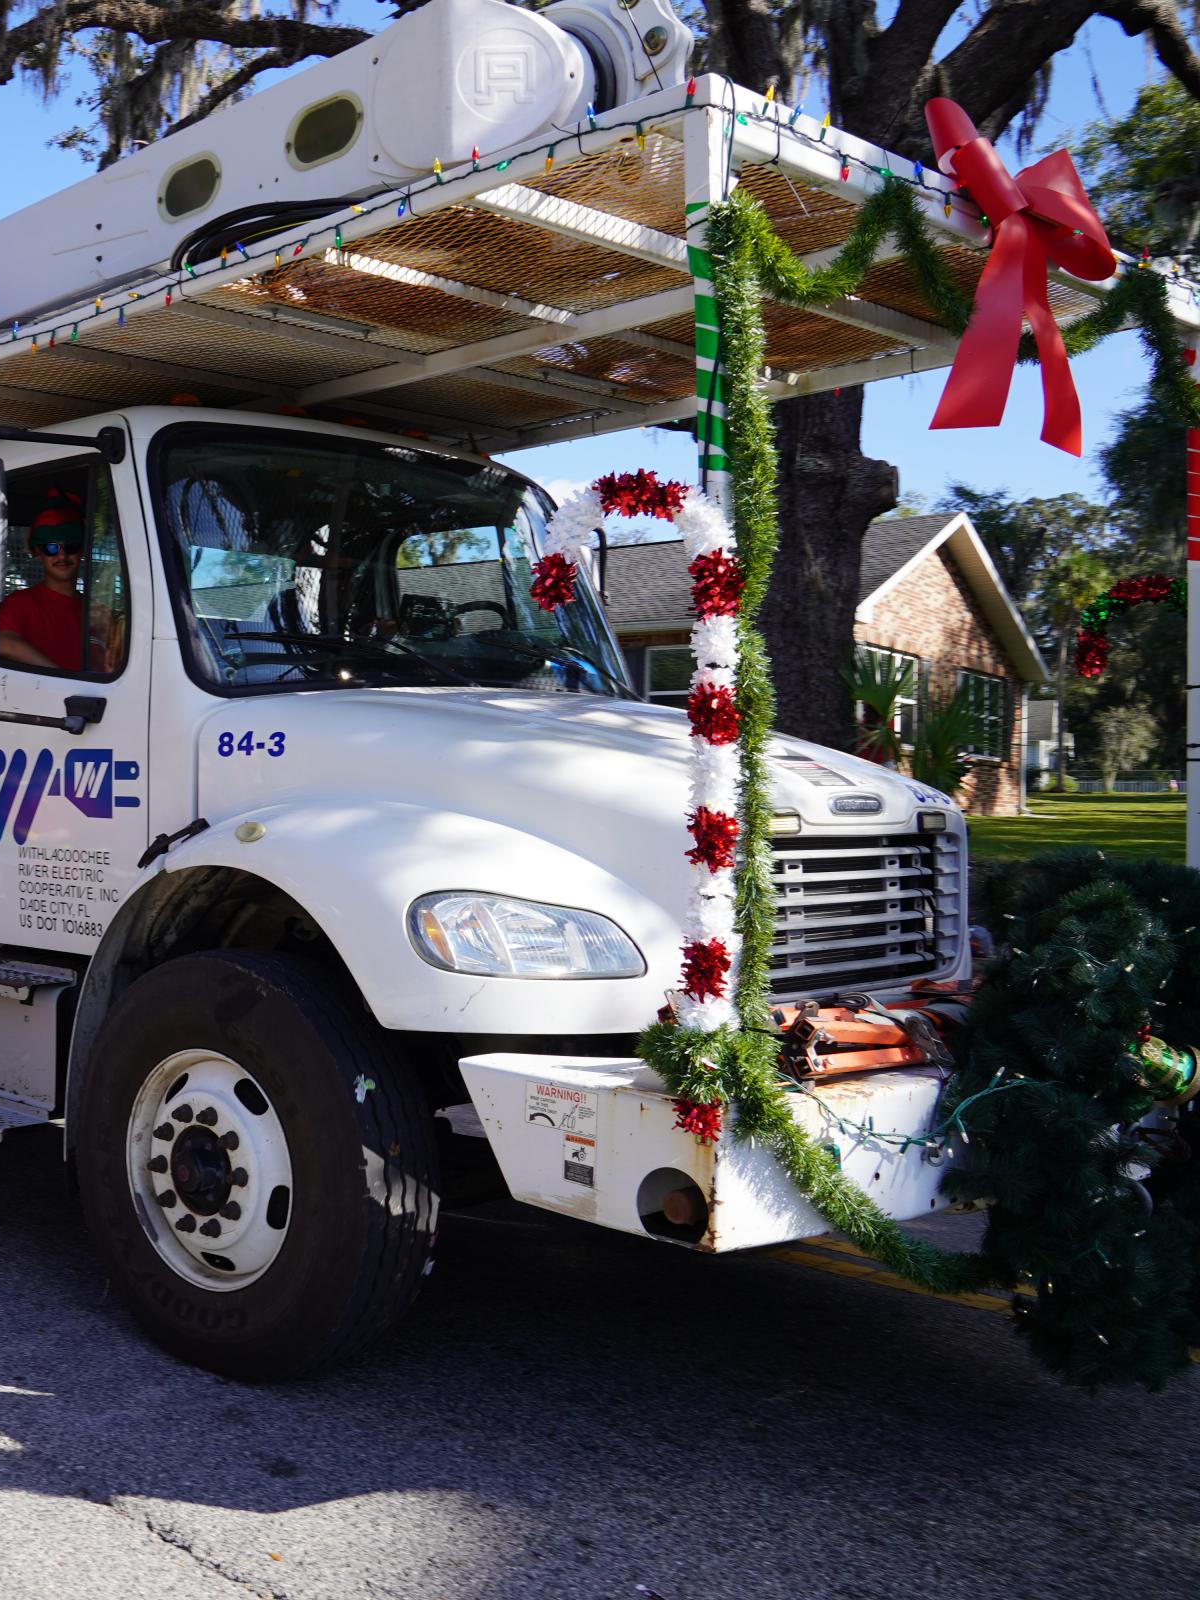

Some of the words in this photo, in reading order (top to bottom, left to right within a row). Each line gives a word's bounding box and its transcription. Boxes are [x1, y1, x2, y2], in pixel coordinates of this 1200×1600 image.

[218, 731, 286, 757] 84-3
[18, 846, 111, 866] WITHLACOOCHEE
[18, 863, 49, 878] RIVER
[52, 865, 105, 883] ELECTRIC
[18, 880, 97, 903] COOPERATIVE,
[100, 887, 120, 903] INC
[19, 897, 47, 913] DADE
[49, 901, 76, 918] CITY,
[78, 903, 91, 918] FL
[19, 914, 33, 929] US
[36, 915, 57, 931] DOT
[61, 918, 104, 938] 1016883
[536, 1084, 587, 1105] WARNING!!
